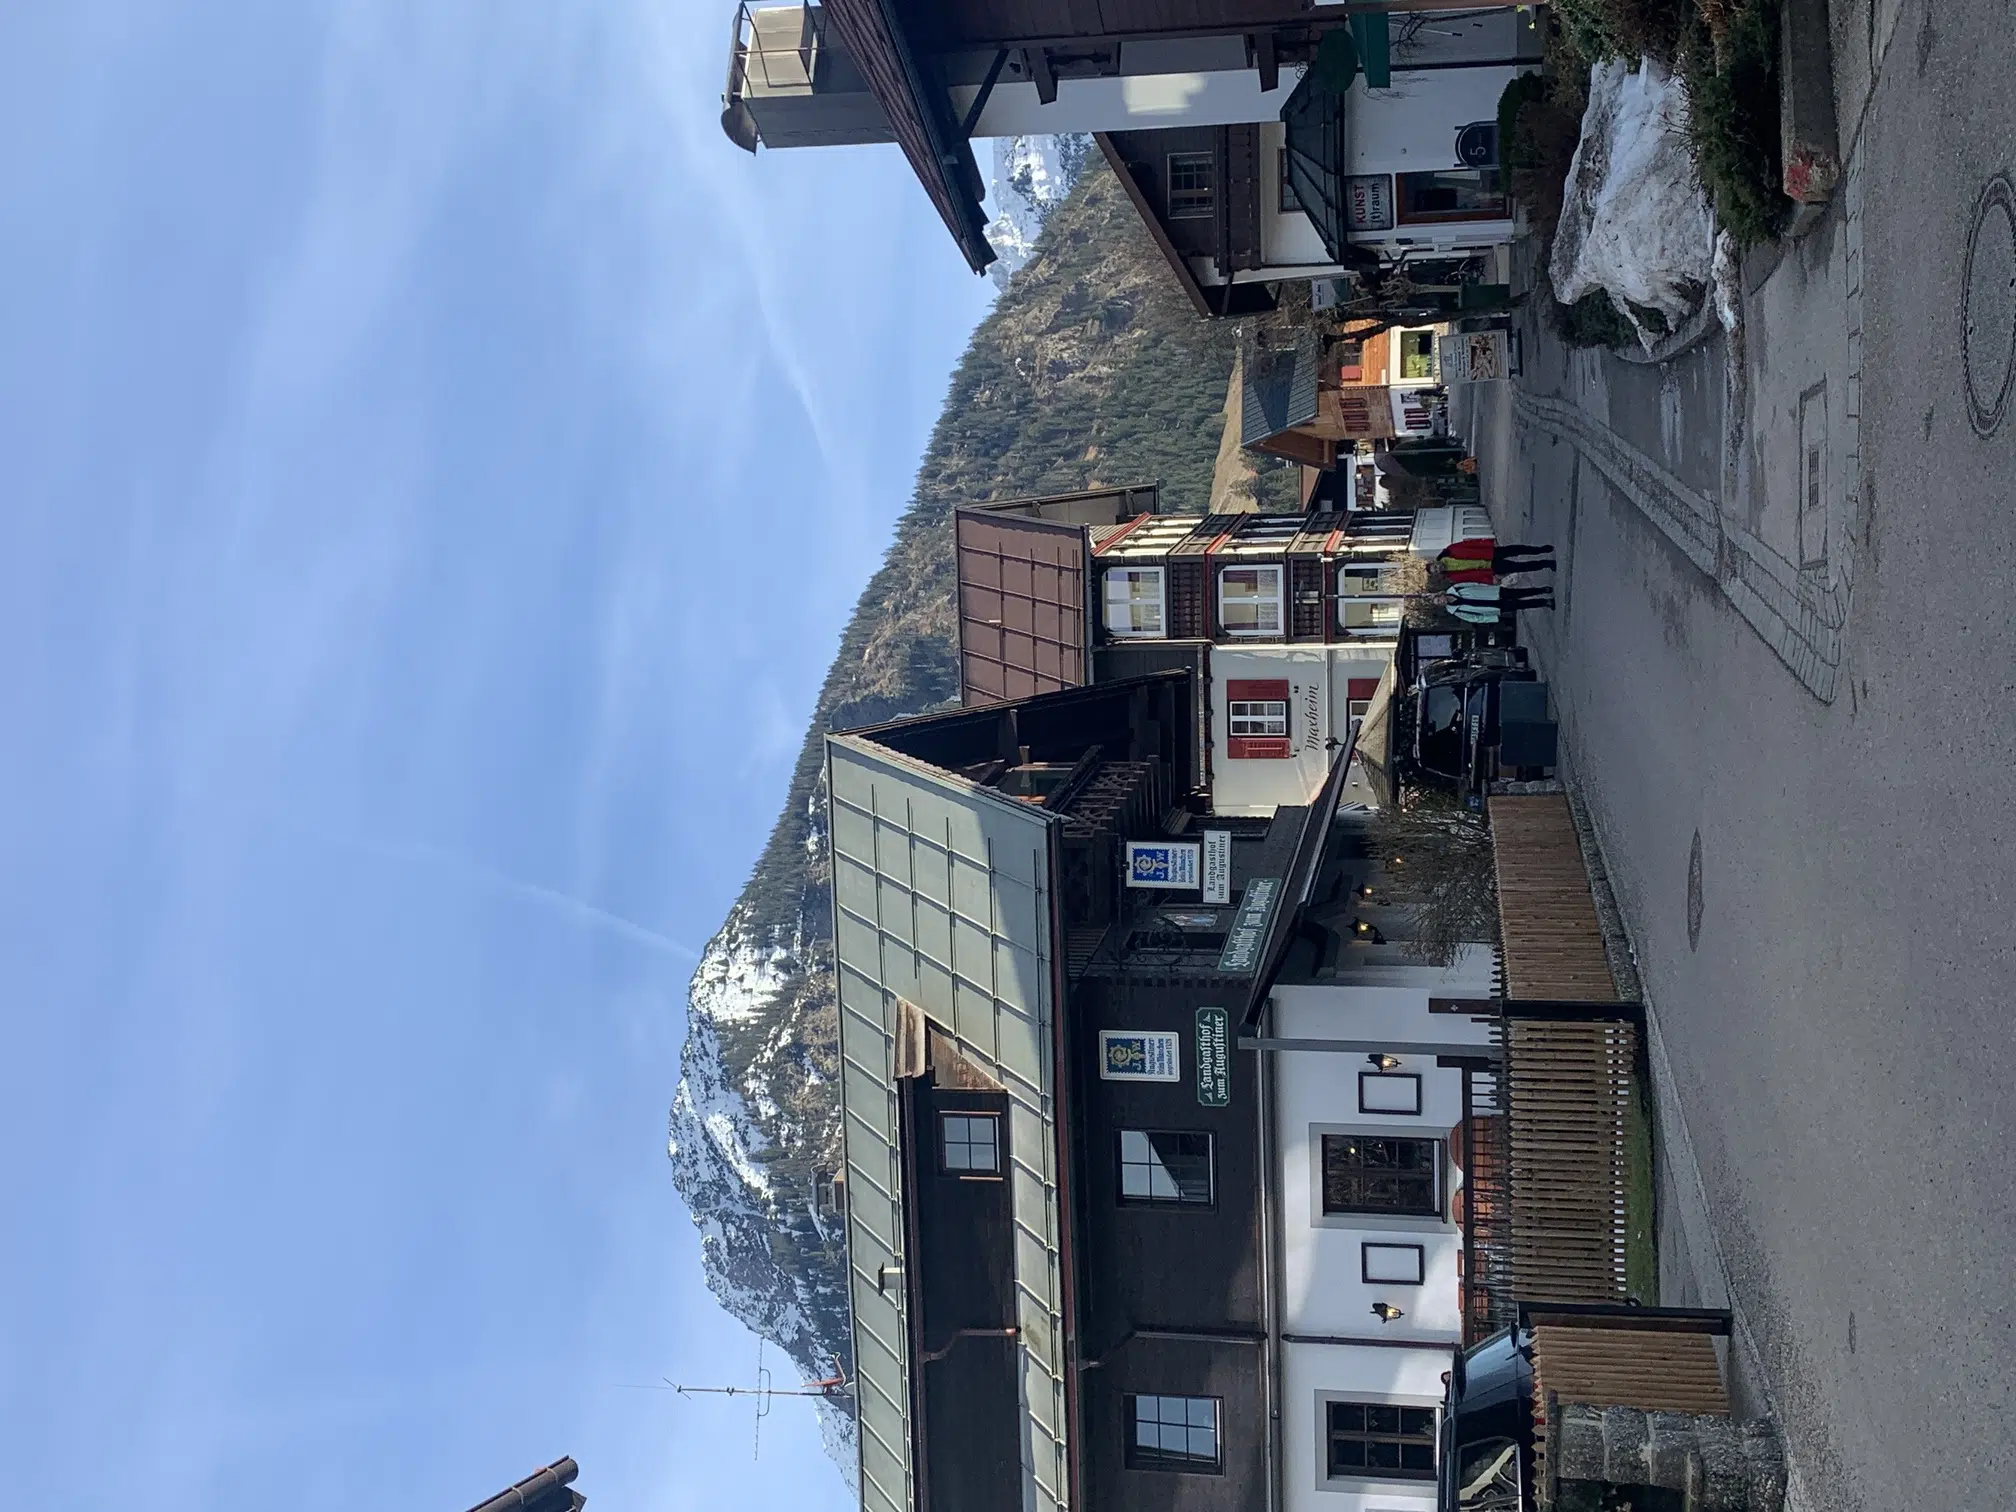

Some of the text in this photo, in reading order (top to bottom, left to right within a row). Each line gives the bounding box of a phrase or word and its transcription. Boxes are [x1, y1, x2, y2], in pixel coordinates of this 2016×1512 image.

[1470, 146, 1486, 155] 5
[1354, 184, 1366, 224] KUNST
[1304, 682, 1320, 751] Maxheim
[1207, 841, 1217, 892] Landgasthof
[1216, 835, 1226, 880] Augustiner
[1243, 913, 1263, 927] zum
[1217, 1078, 1227, 1100] zum
